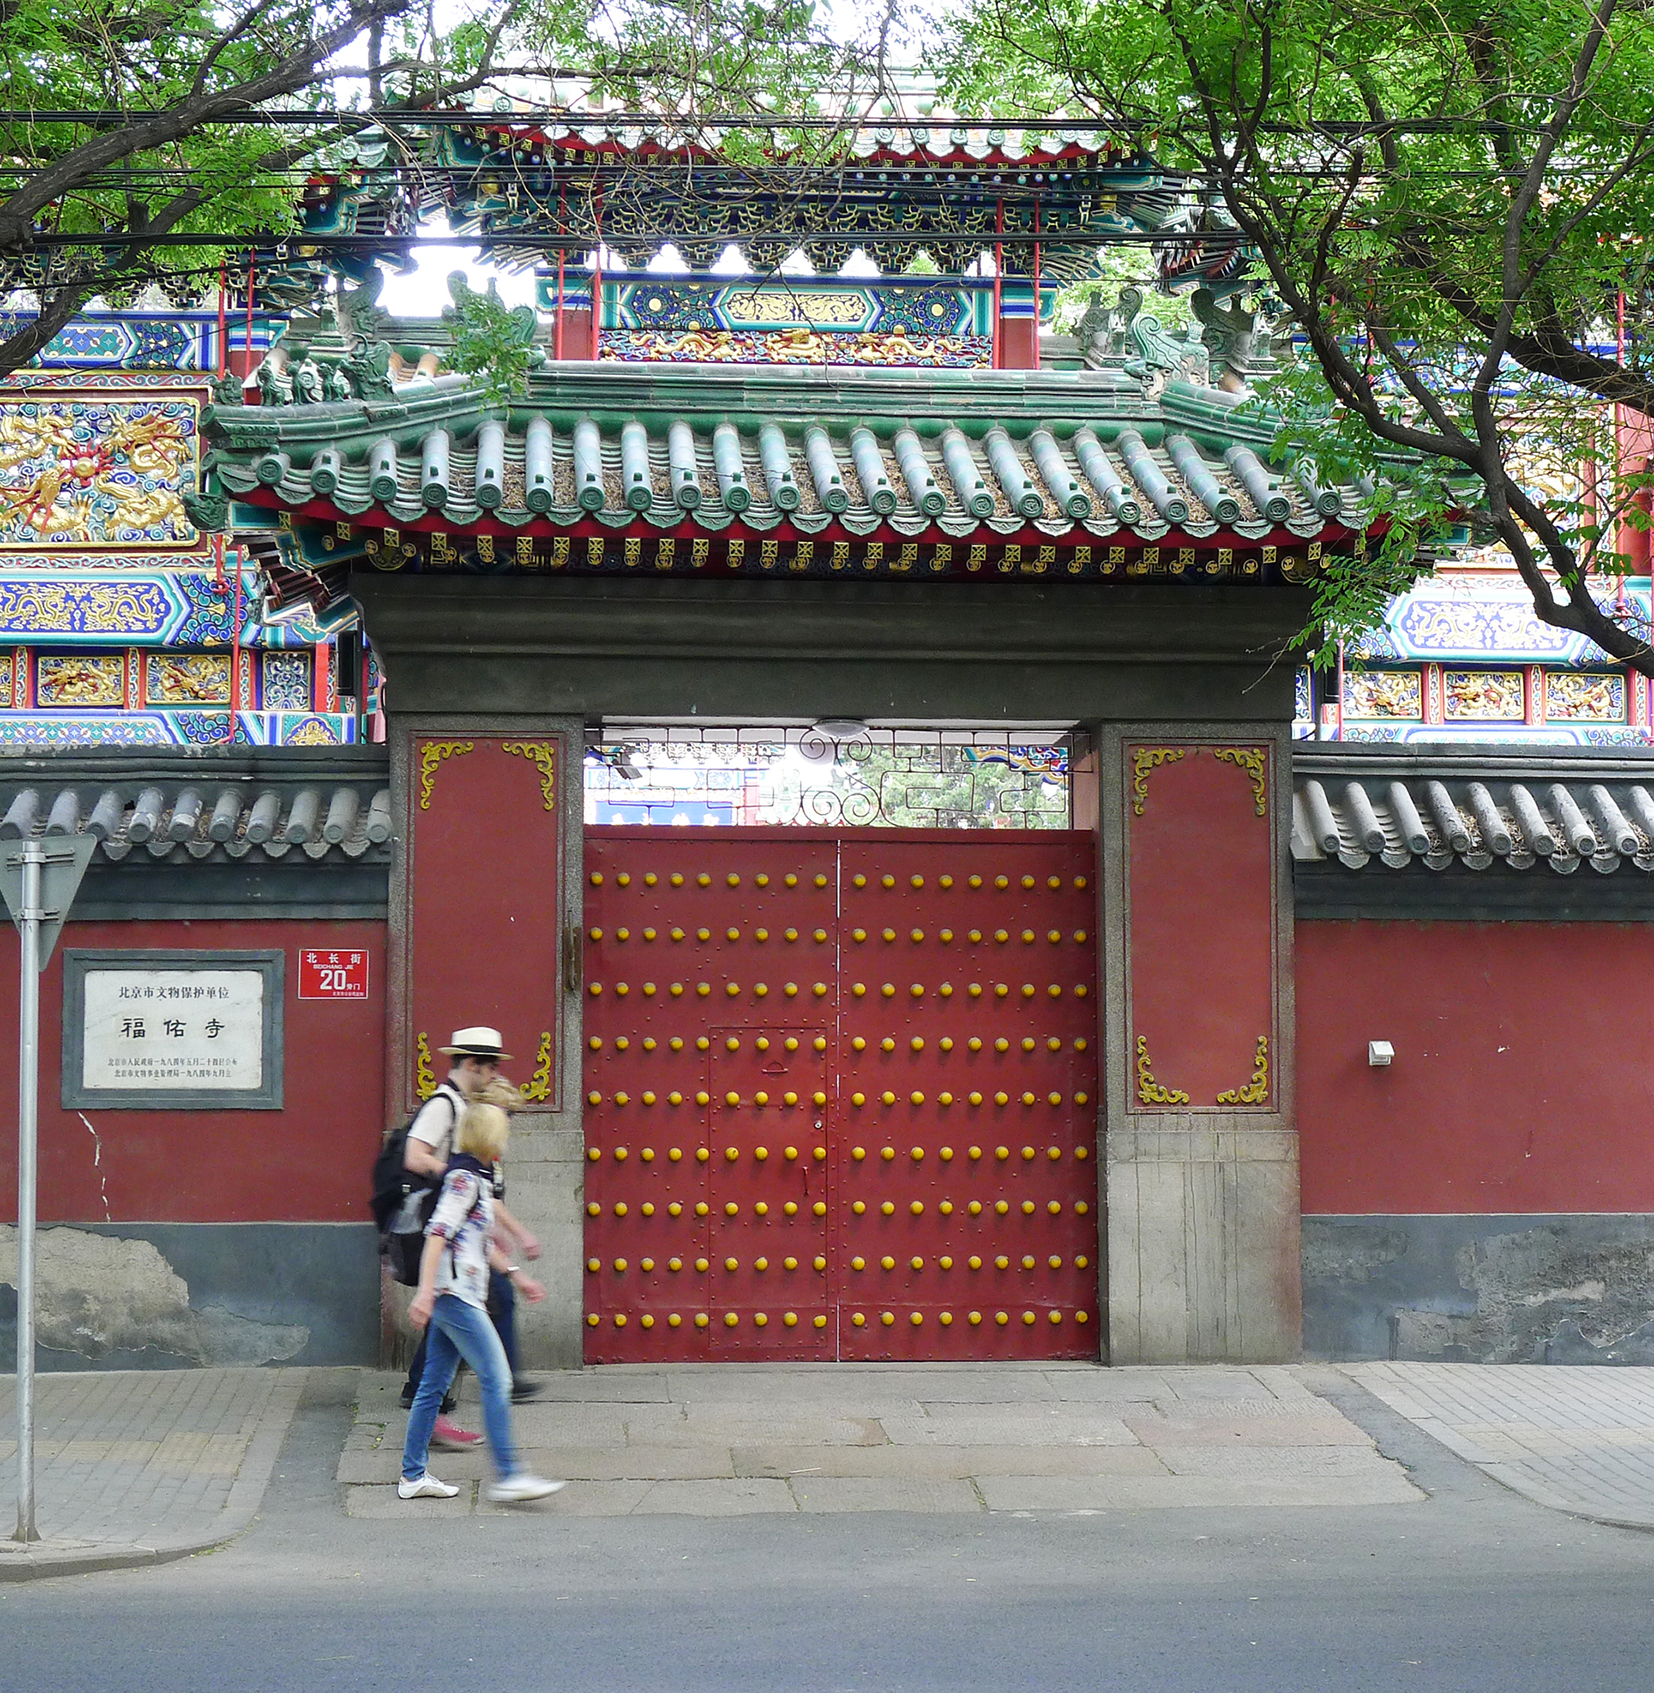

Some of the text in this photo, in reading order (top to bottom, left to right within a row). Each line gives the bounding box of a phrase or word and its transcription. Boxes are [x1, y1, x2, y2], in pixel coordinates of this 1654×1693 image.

[306, 952, 361, 964] 北长街
[320, 969, 347, 990] 20
[118, 985, 230, 1000] 北京市文物保护单位
[121, 1017, 226, 1039] 福佑寺
